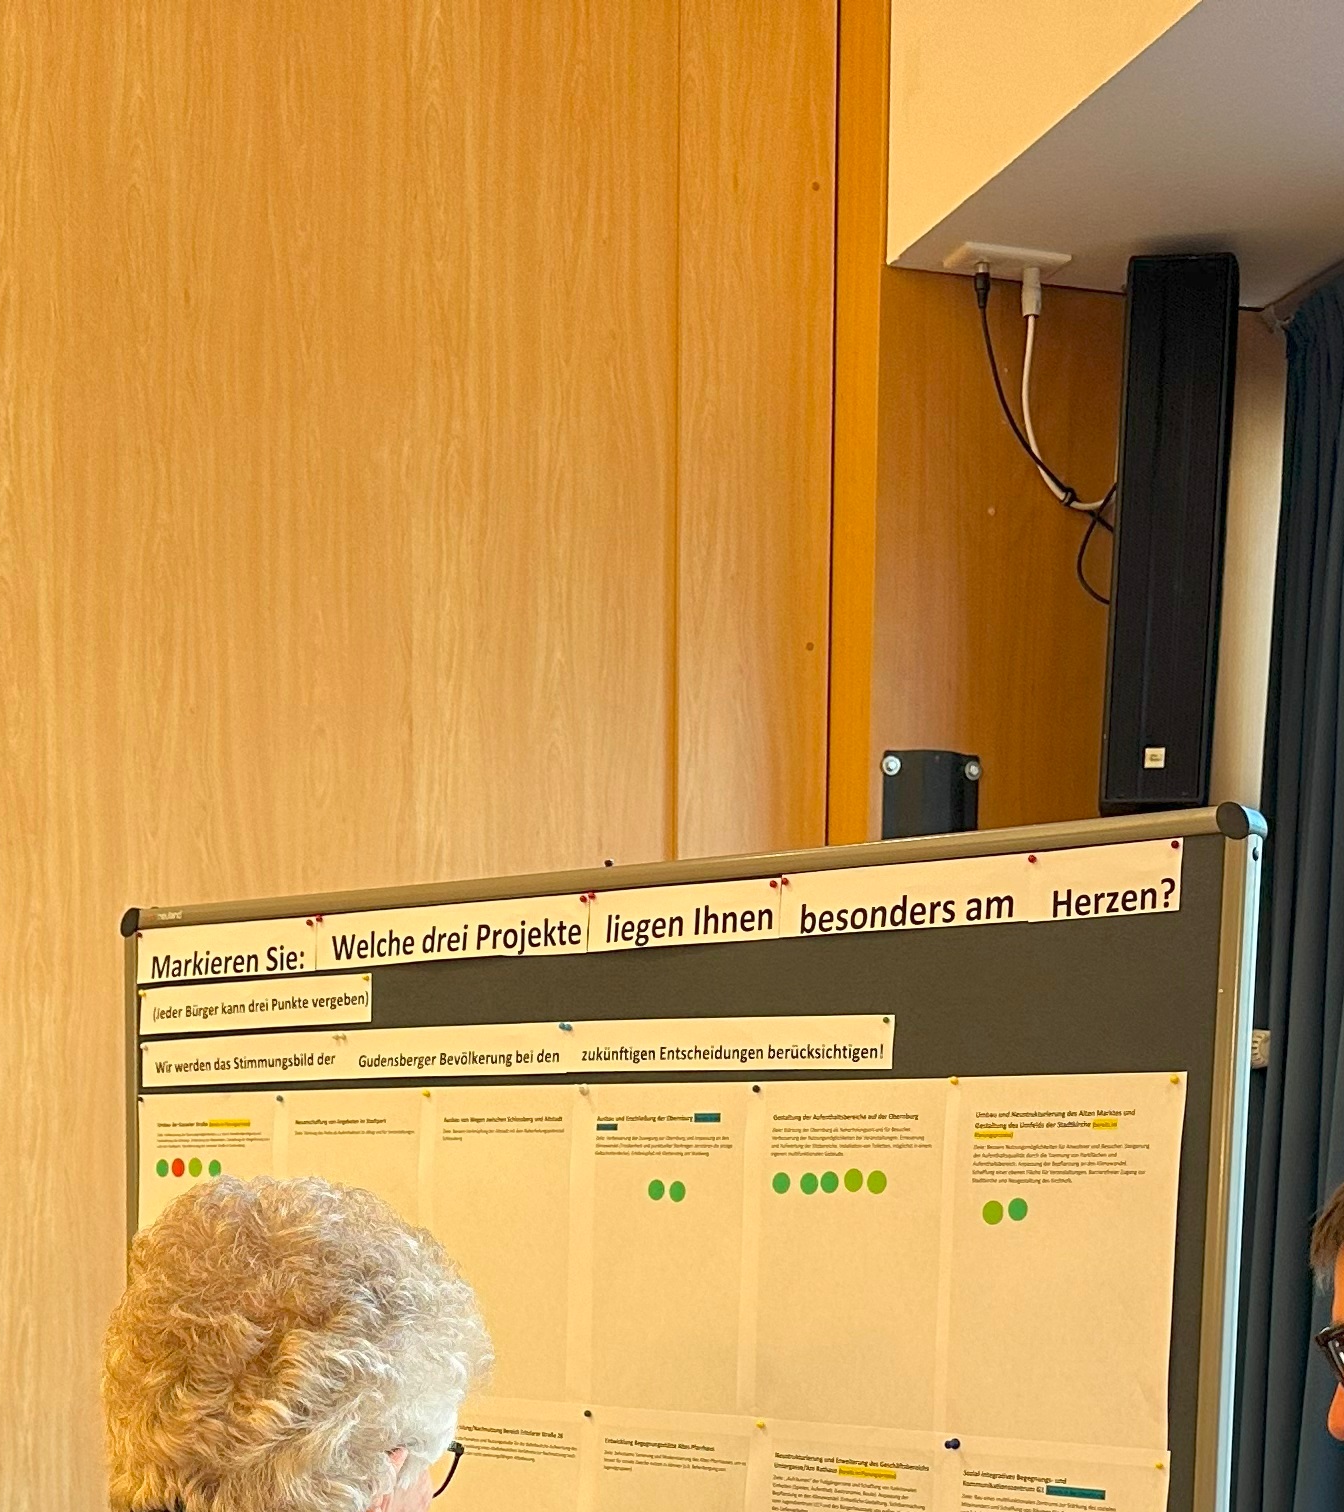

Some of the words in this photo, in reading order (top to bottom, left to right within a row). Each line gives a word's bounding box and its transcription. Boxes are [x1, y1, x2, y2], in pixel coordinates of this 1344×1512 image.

[151, 950, 260, 980] Markieren
[265, 944, 305, 972] Sie:
[331, 929, 415, 961] Welche
[422, 924, 471, 958] drei
[476, 920, 582, 955] Projekte
[607, 914, 683, 944] liegen
[694, 906, 773, 936] Ihnen
[800, 895, 956, 934] besonders
[965, 894, 1015, 924] am
[1052, 878, 1177, 919] Herzen?
[152, 1005, 183, 1023] (Jeder
[185, 1004, 220, 1020] Bürger
[221, 1002, 246, 1015] kann
[248, 998, 269, 1013] drei
[271, 995, 309, 1012] Punkte
[311, 990, 369, 1011] vergeben)
[154, 1060, 173, 1074] Wir
[174, 1058, 212, 1073] werden
[213, 1057, 231, 1071] das
[233, 1052, 314, 1071] Stimmungsbild
[316, 1052, 336, 1066] der
[358, 1052, 437, 1070] Gudensberger
[439, 1050, 513, 1068] Bevölkerung
[515, 1049, 534, 1064] bei
[536, 1048, 560, 1064] den
[581, 1046, 656, 1064] zukünftigen
[659, 1044, 764, 1064] Entscheidungen
[767, 1043, 884, 1063] berücksichtigen!
